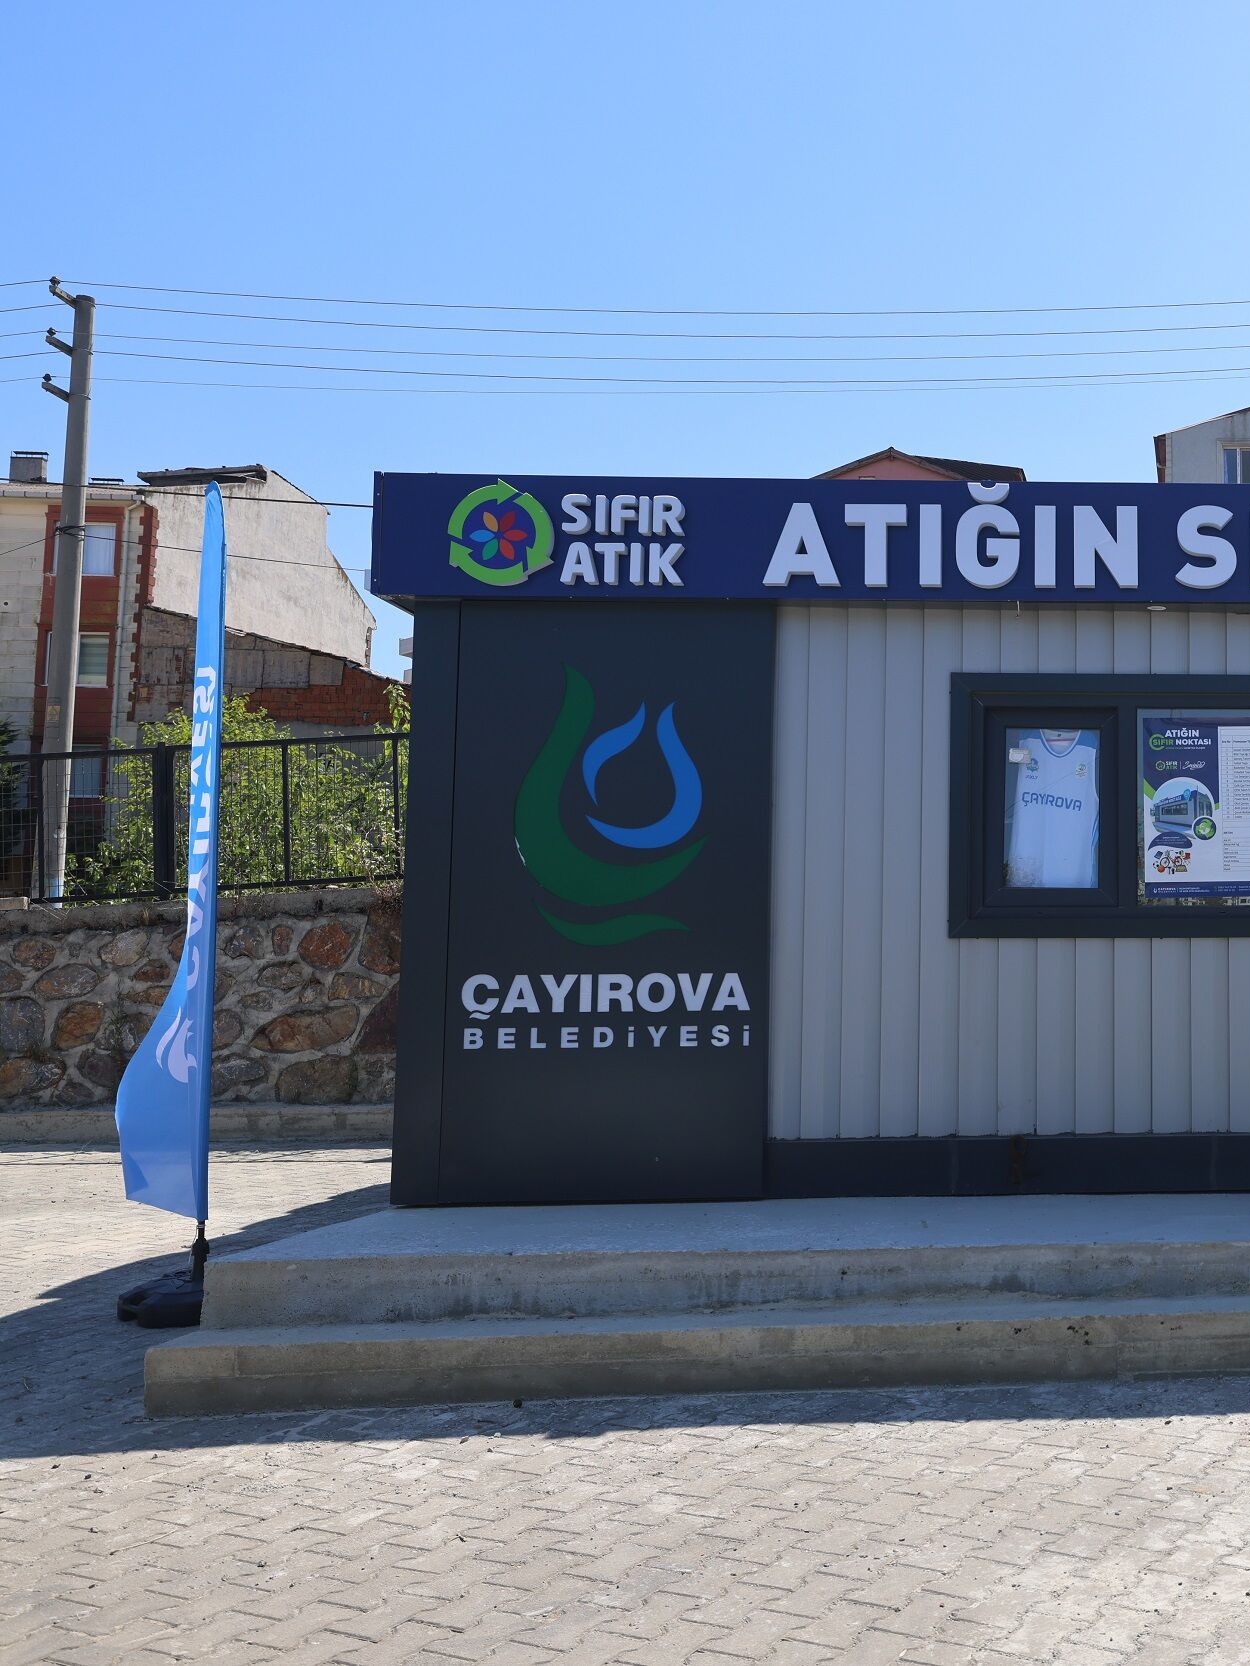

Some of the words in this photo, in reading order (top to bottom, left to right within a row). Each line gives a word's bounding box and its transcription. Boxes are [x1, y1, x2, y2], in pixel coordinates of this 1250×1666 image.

[560, 493, 686, 536] SIFIR
[762, 482, 1139, 589] ATIĞIN
[560, 541, 685, 587] ATIK
[1165, 727, 1199, 738] ATIĞIN
[1175, 738, 1212, 746] NOKTASI
[461, 972, 750, 1020] ÇAYIROVA
[462, 1024, 750, 1050] BELEDİYESİ
